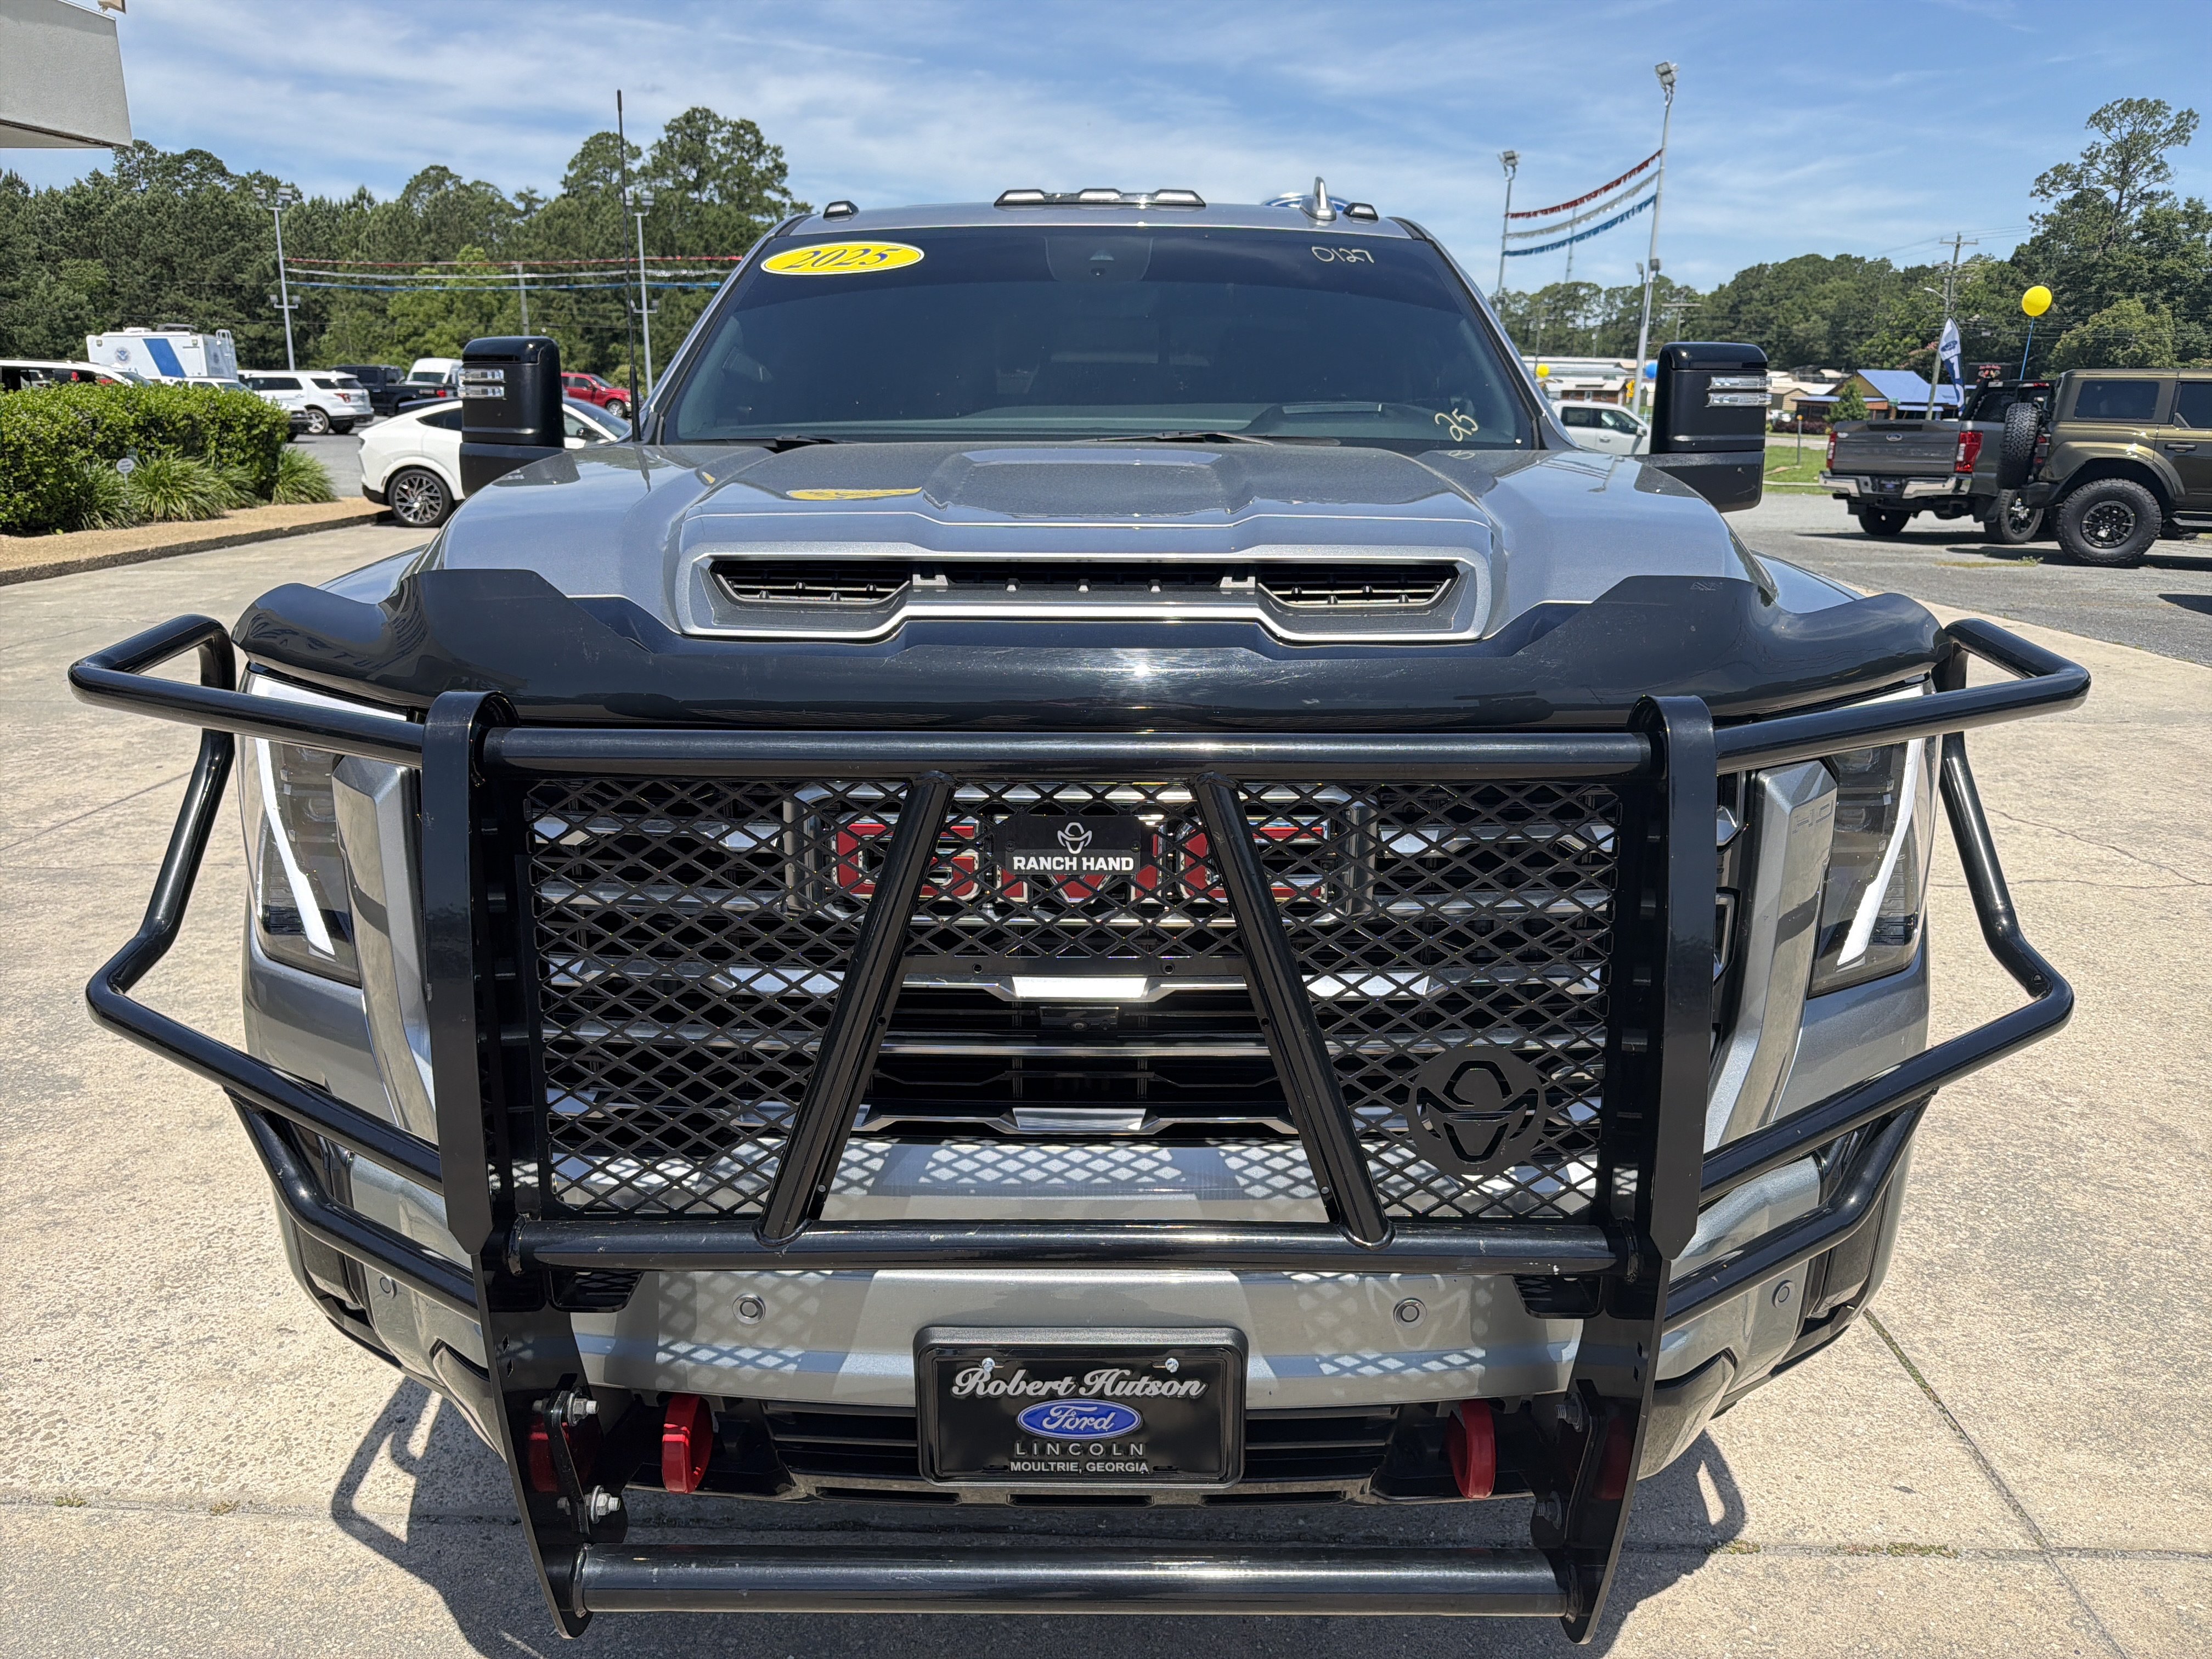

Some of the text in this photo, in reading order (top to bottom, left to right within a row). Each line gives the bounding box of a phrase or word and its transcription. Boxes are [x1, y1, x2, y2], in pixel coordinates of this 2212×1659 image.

[781, 248, 901, 269] 2025
[1311, 246, 1375, 264] 0127
[1013, 856, 1134, 871] RANCH HAND
[952, 1368, 1206, 1397] Robert Hutson
[1043, 1405, 1115, 1431] Ford
[1016, 1443, 1144, 1456] LINCOLN
[1010, 1462, 1149, 1473] MOULTRIE, GEORGIA
